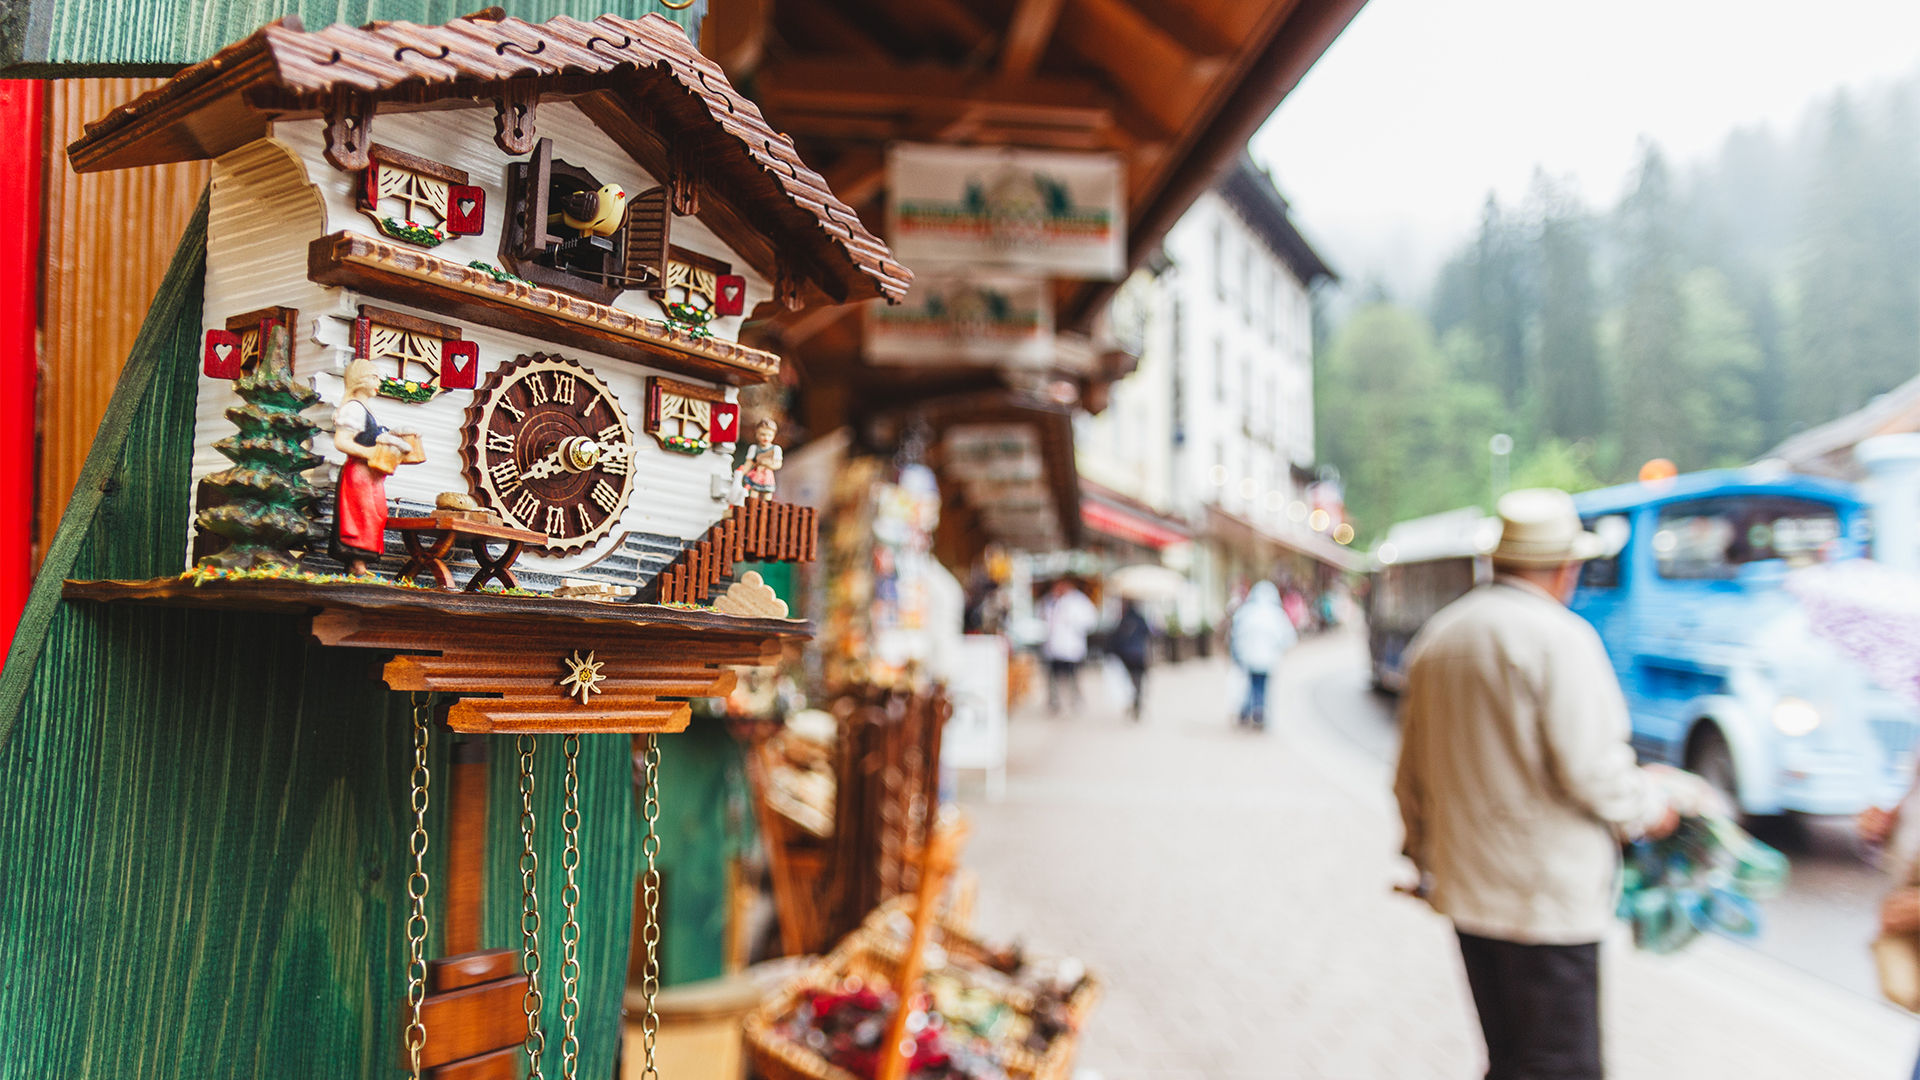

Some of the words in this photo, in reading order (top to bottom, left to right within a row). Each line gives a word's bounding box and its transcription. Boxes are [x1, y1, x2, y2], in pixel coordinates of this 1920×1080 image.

[525, 373, 549, 406] XI
[553, 372, 576, 405] XII
[498, 392, 525, 422] X
